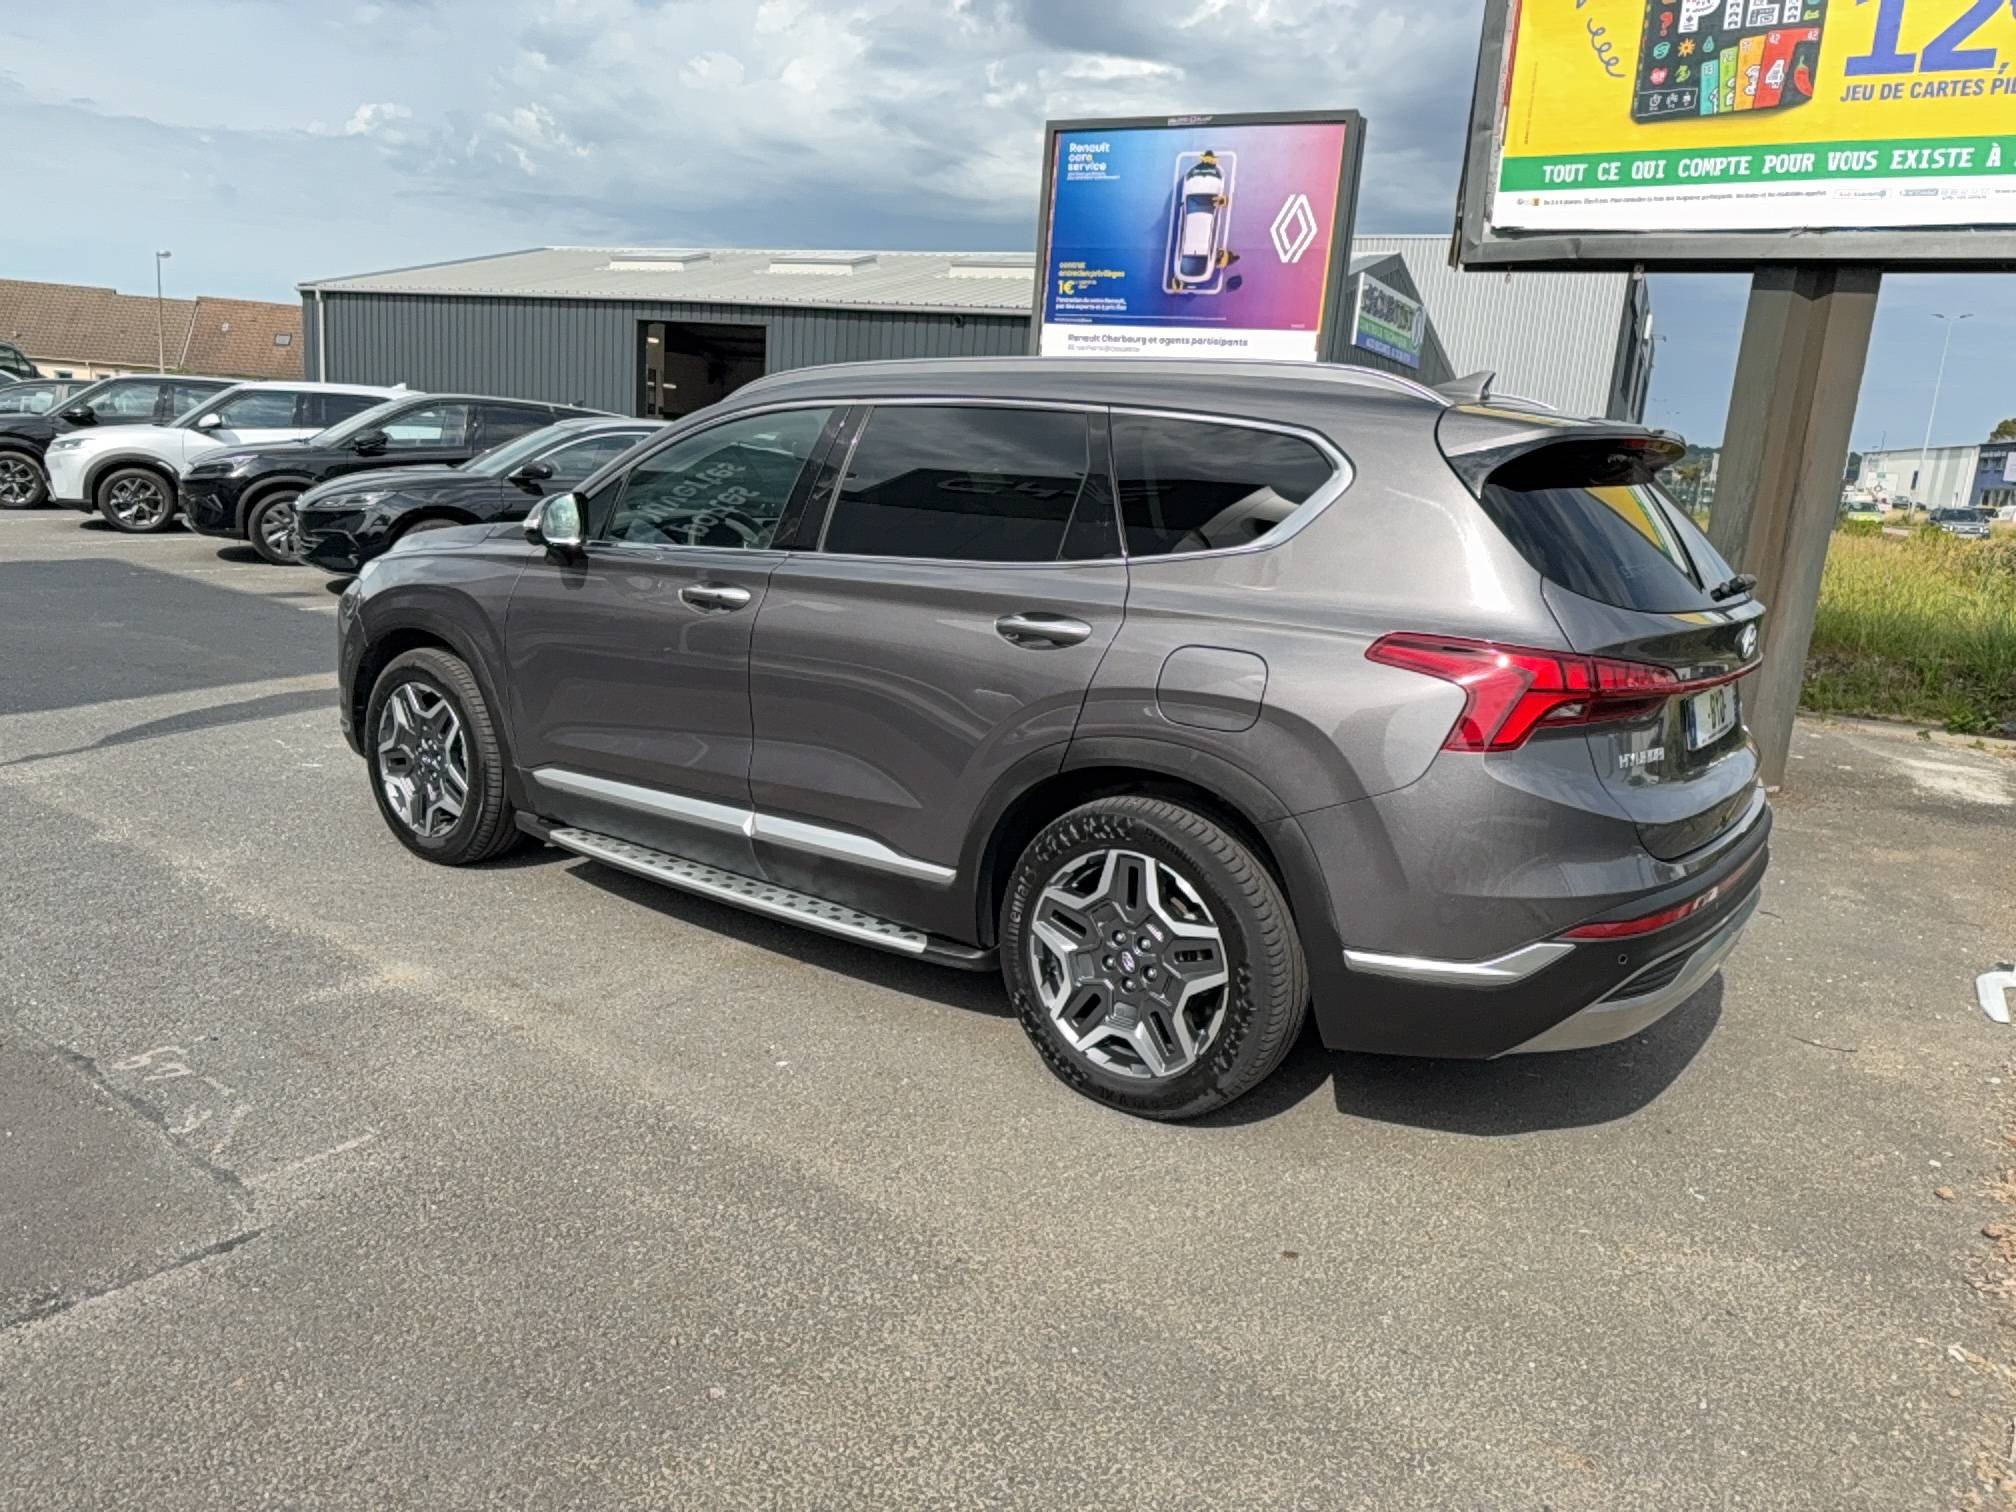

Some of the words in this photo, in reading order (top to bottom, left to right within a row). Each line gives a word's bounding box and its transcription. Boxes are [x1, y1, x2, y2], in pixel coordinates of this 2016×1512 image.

[1845, 0, 2016, 76] 12,
[1840, 84, 1875, 102] JEU
[1879, 82, 1905, 100] DE
[1910, 78, 1985, 99] CARTES
[1069, 142, 1110, 152] Renault
[1068, 153, 1093, 162] care
[1543, 163, 1588, 183] TOUT
[1597, 161, 1621, 181] CE
[1631, 159, 1667, 180] QUI
[1678, 155, 1752, 177] COMPTE
[1762, 153, 1815, 174] POUR
[1827, 150, 1879, 171] VOUS
[1889, 147, 1975, 170] EXISTE
[1985, 142, 2001, 168] À
[1067, 162, 1107, 171] service
[1068, 334, 1101, 343] Renault
[1101, 334, 1147, 345] Cherbourg
[1159, 337, 1190, 346] agents
[1190, 338, 1248, 347] participants
